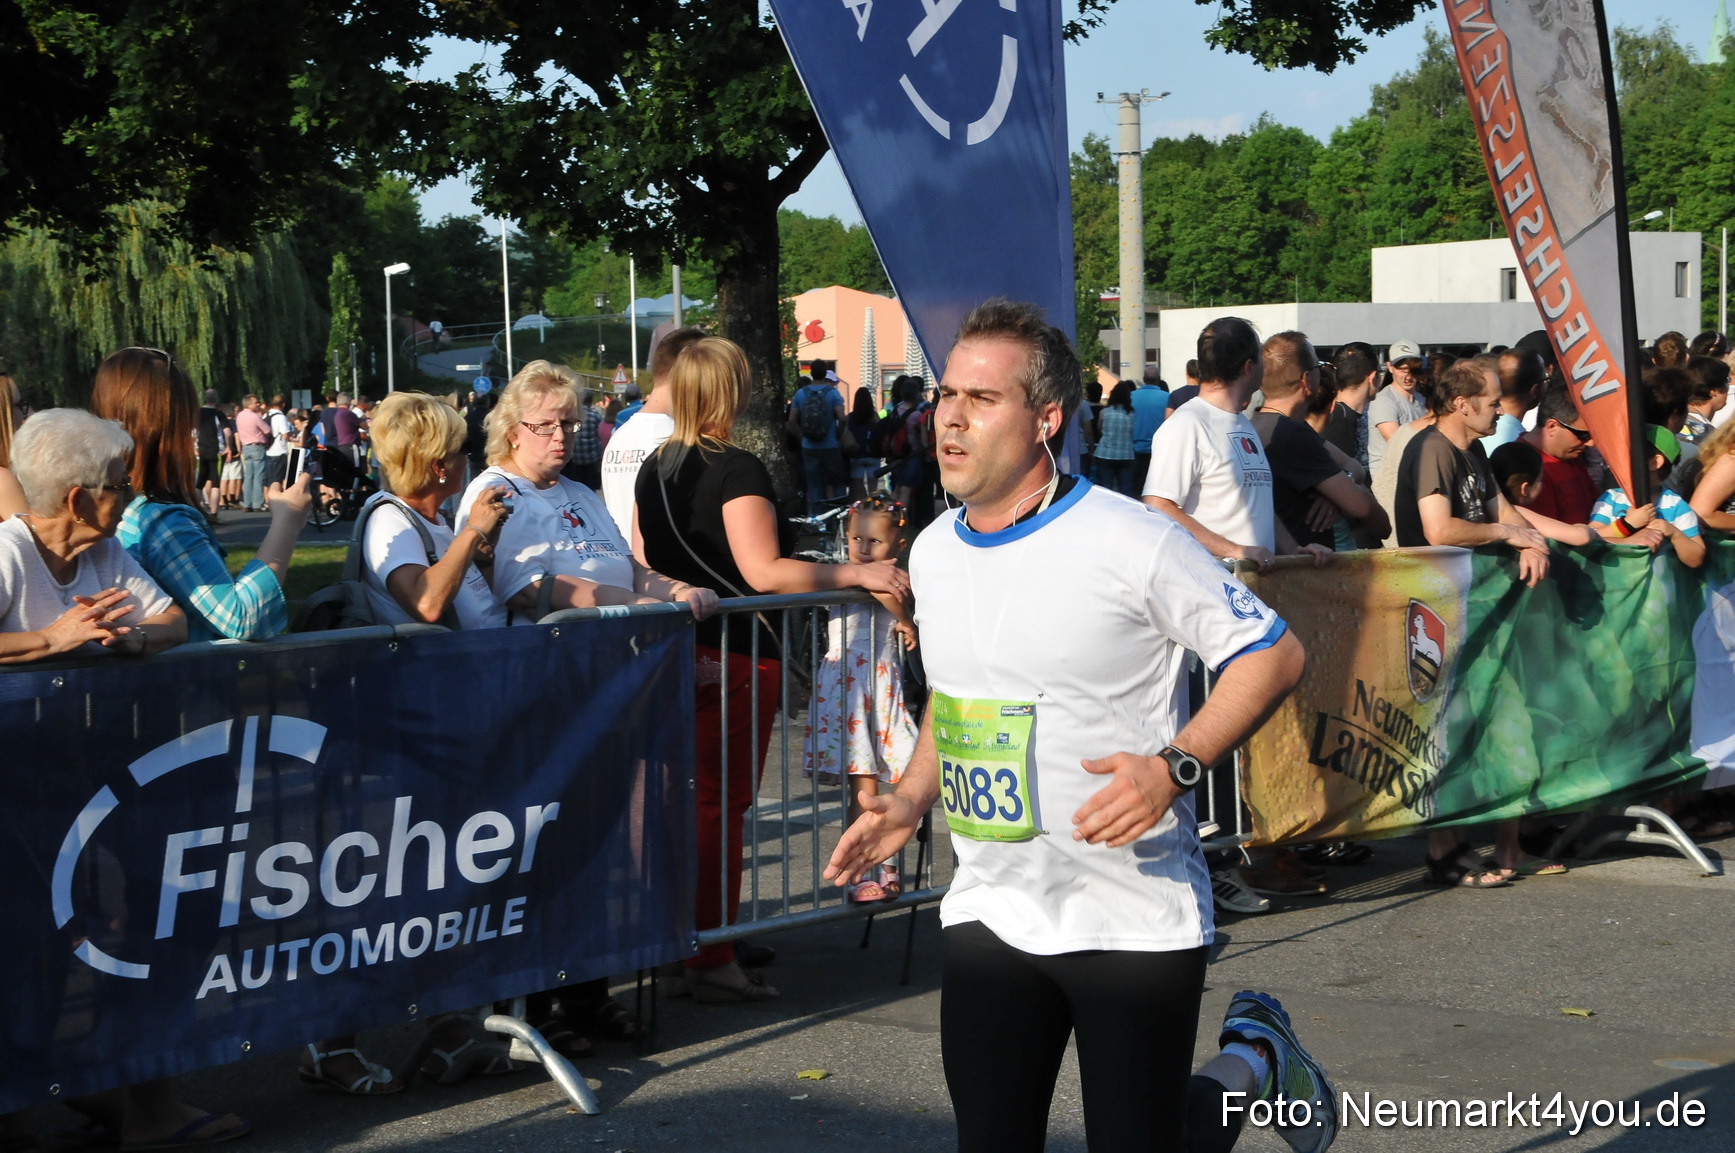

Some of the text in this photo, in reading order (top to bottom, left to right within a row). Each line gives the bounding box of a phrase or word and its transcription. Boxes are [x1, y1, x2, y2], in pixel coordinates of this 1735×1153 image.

[605, 449, 647, 465] OLGER
[942, 760, 1024, 822] 5083
[154, 795, 561, 940] Fischer
[195, 895, 528, 999] AUTOMOBILE
